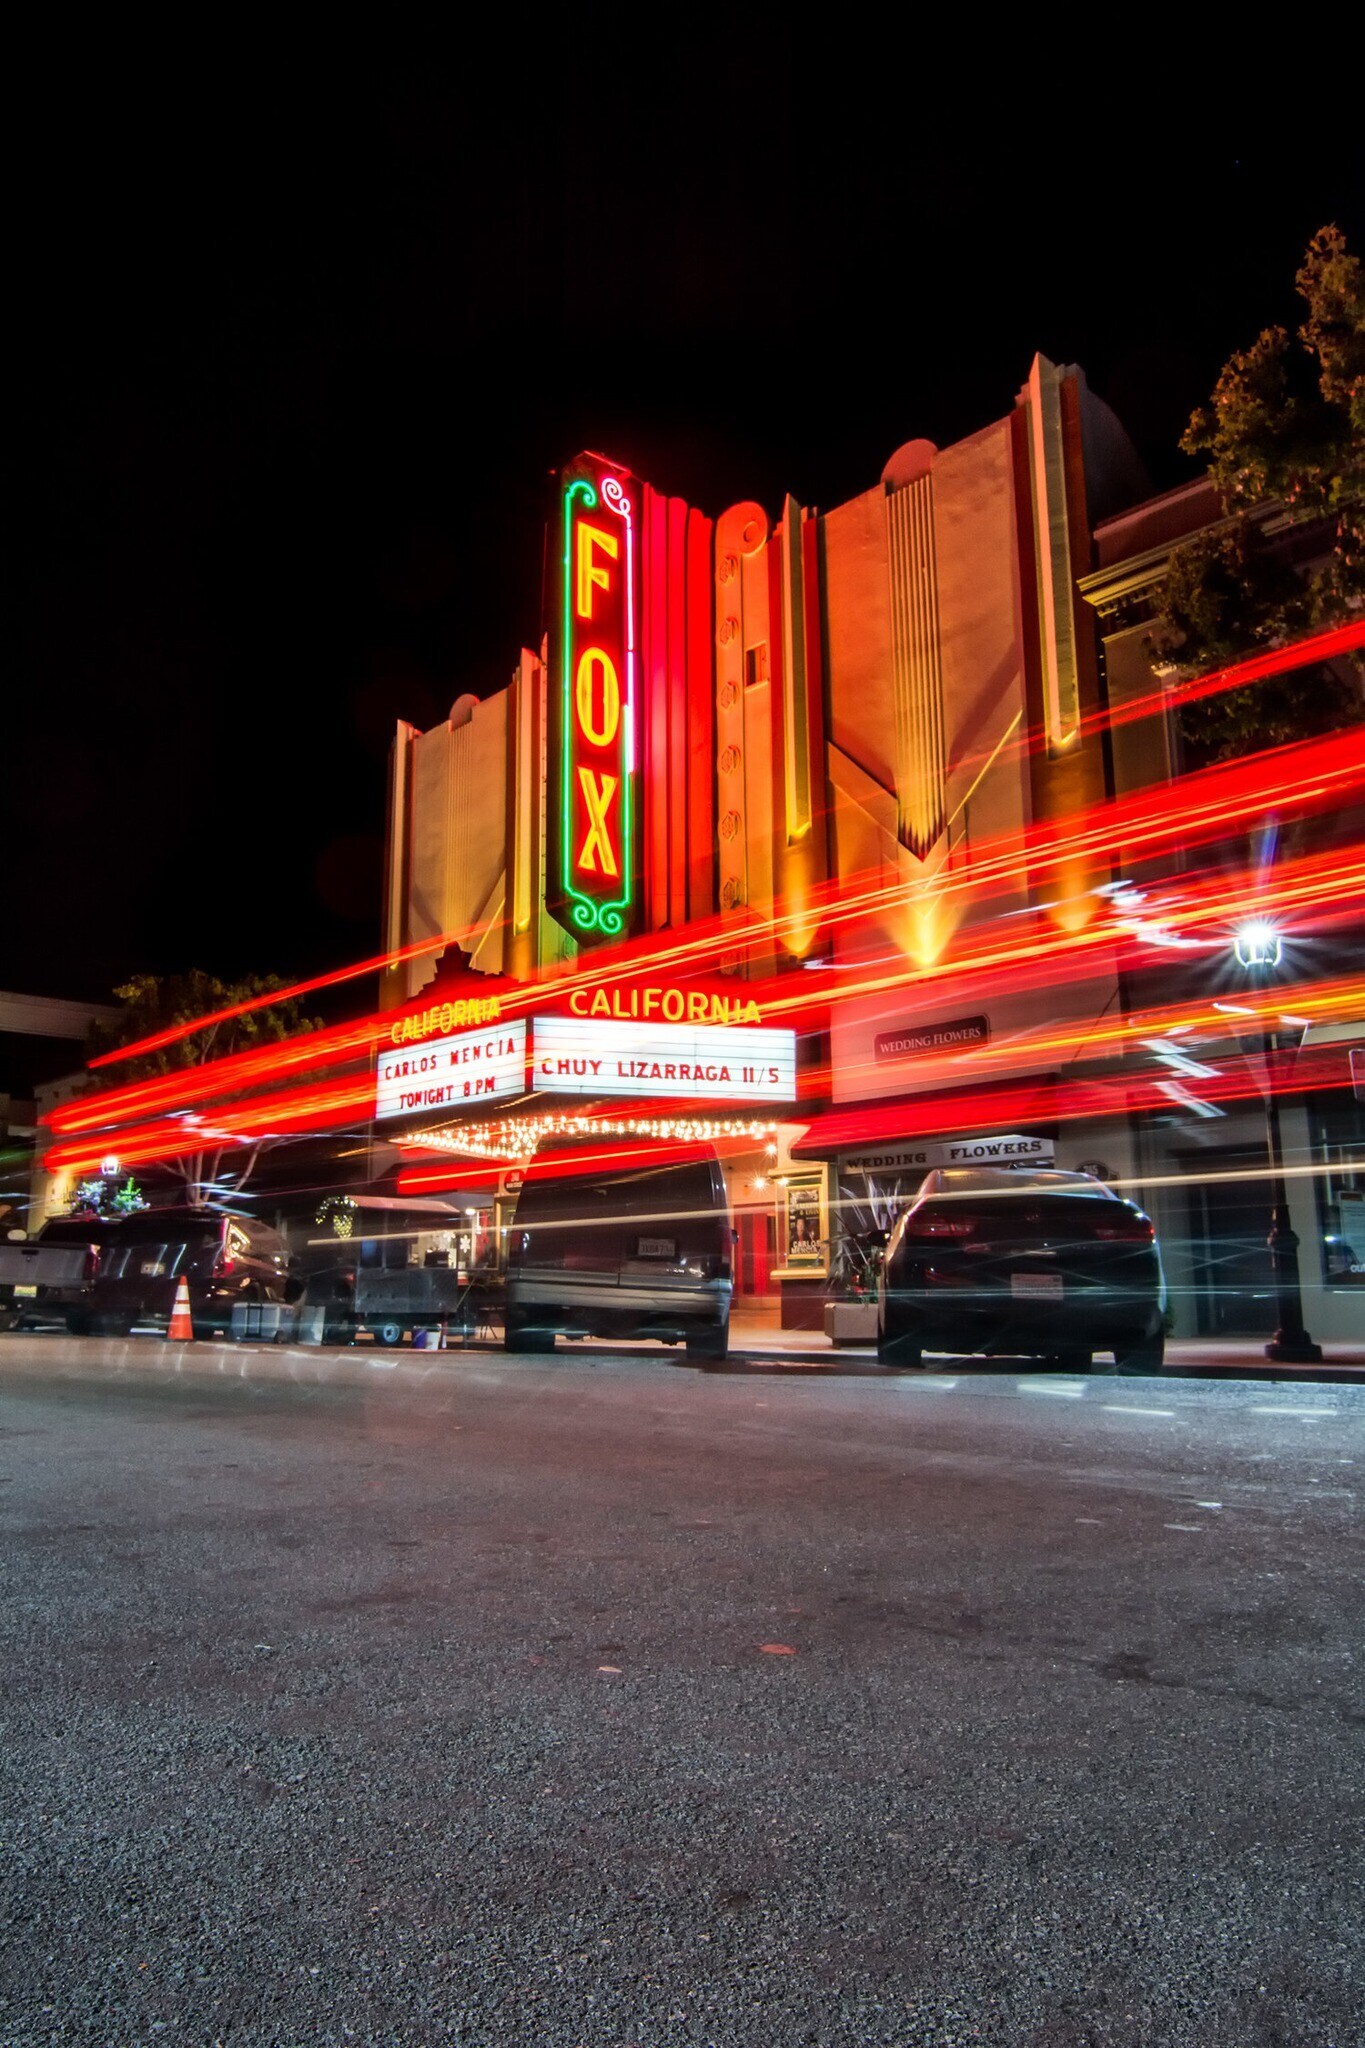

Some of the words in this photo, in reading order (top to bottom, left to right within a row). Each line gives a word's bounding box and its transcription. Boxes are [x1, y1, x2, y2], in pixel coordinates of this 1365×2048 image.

[576, 520, 619, 877] FOX
[391, 996, 500, 1043] CALIFORNIA
[569, 988, 762, 1023] CALIFORNIA
[880, 1035, 931, 1053] WEDDING
[933, 1027, 981, 1045] FLOWERS
[385, 1054, 437, 1080] CARLOS
[450, 1037, 515, 1066] MENCIA
[541, 1057, 602, 1075] CHUY
[617, 1061, 731, 1082] LIZARRAGA
[742, 1067, 779, 1085] 11/5
[400, 1085, 454, 1109] TONIGHT
[847, 1152, 927, 1169] WEDDING
[950, 1140, 1042, 1160] FLOWERS
